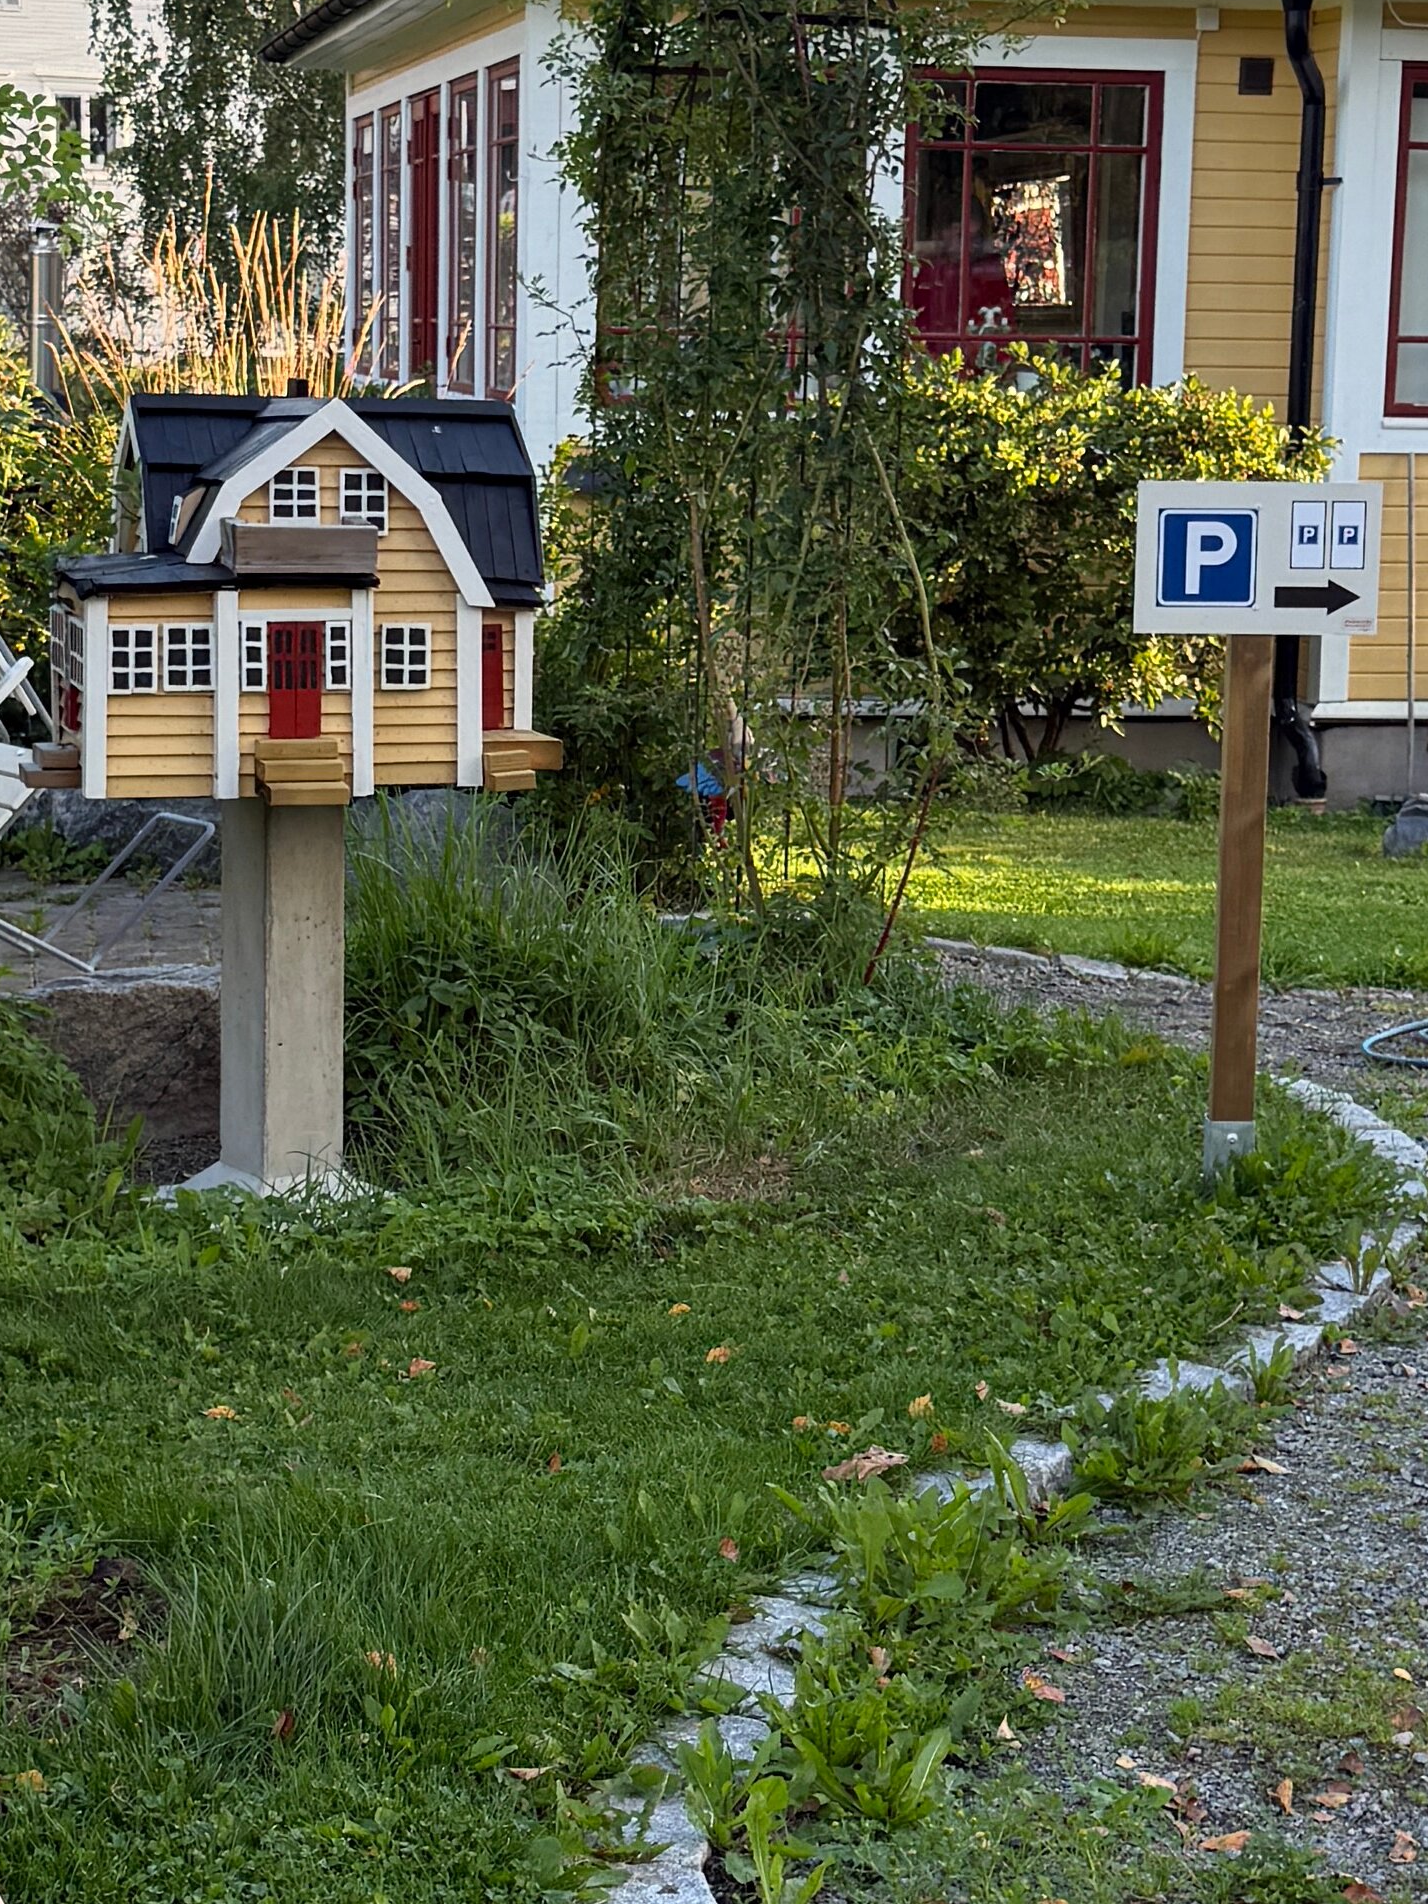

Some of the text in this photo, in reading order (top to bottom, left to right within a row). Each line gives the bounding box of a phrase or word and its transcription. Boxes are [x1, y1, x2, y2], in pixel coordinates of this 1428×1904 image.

[1303, 527, 1315, 543] P
[1343, 527, 1355, 544] P
[1185, 521, 1237, 594] P
